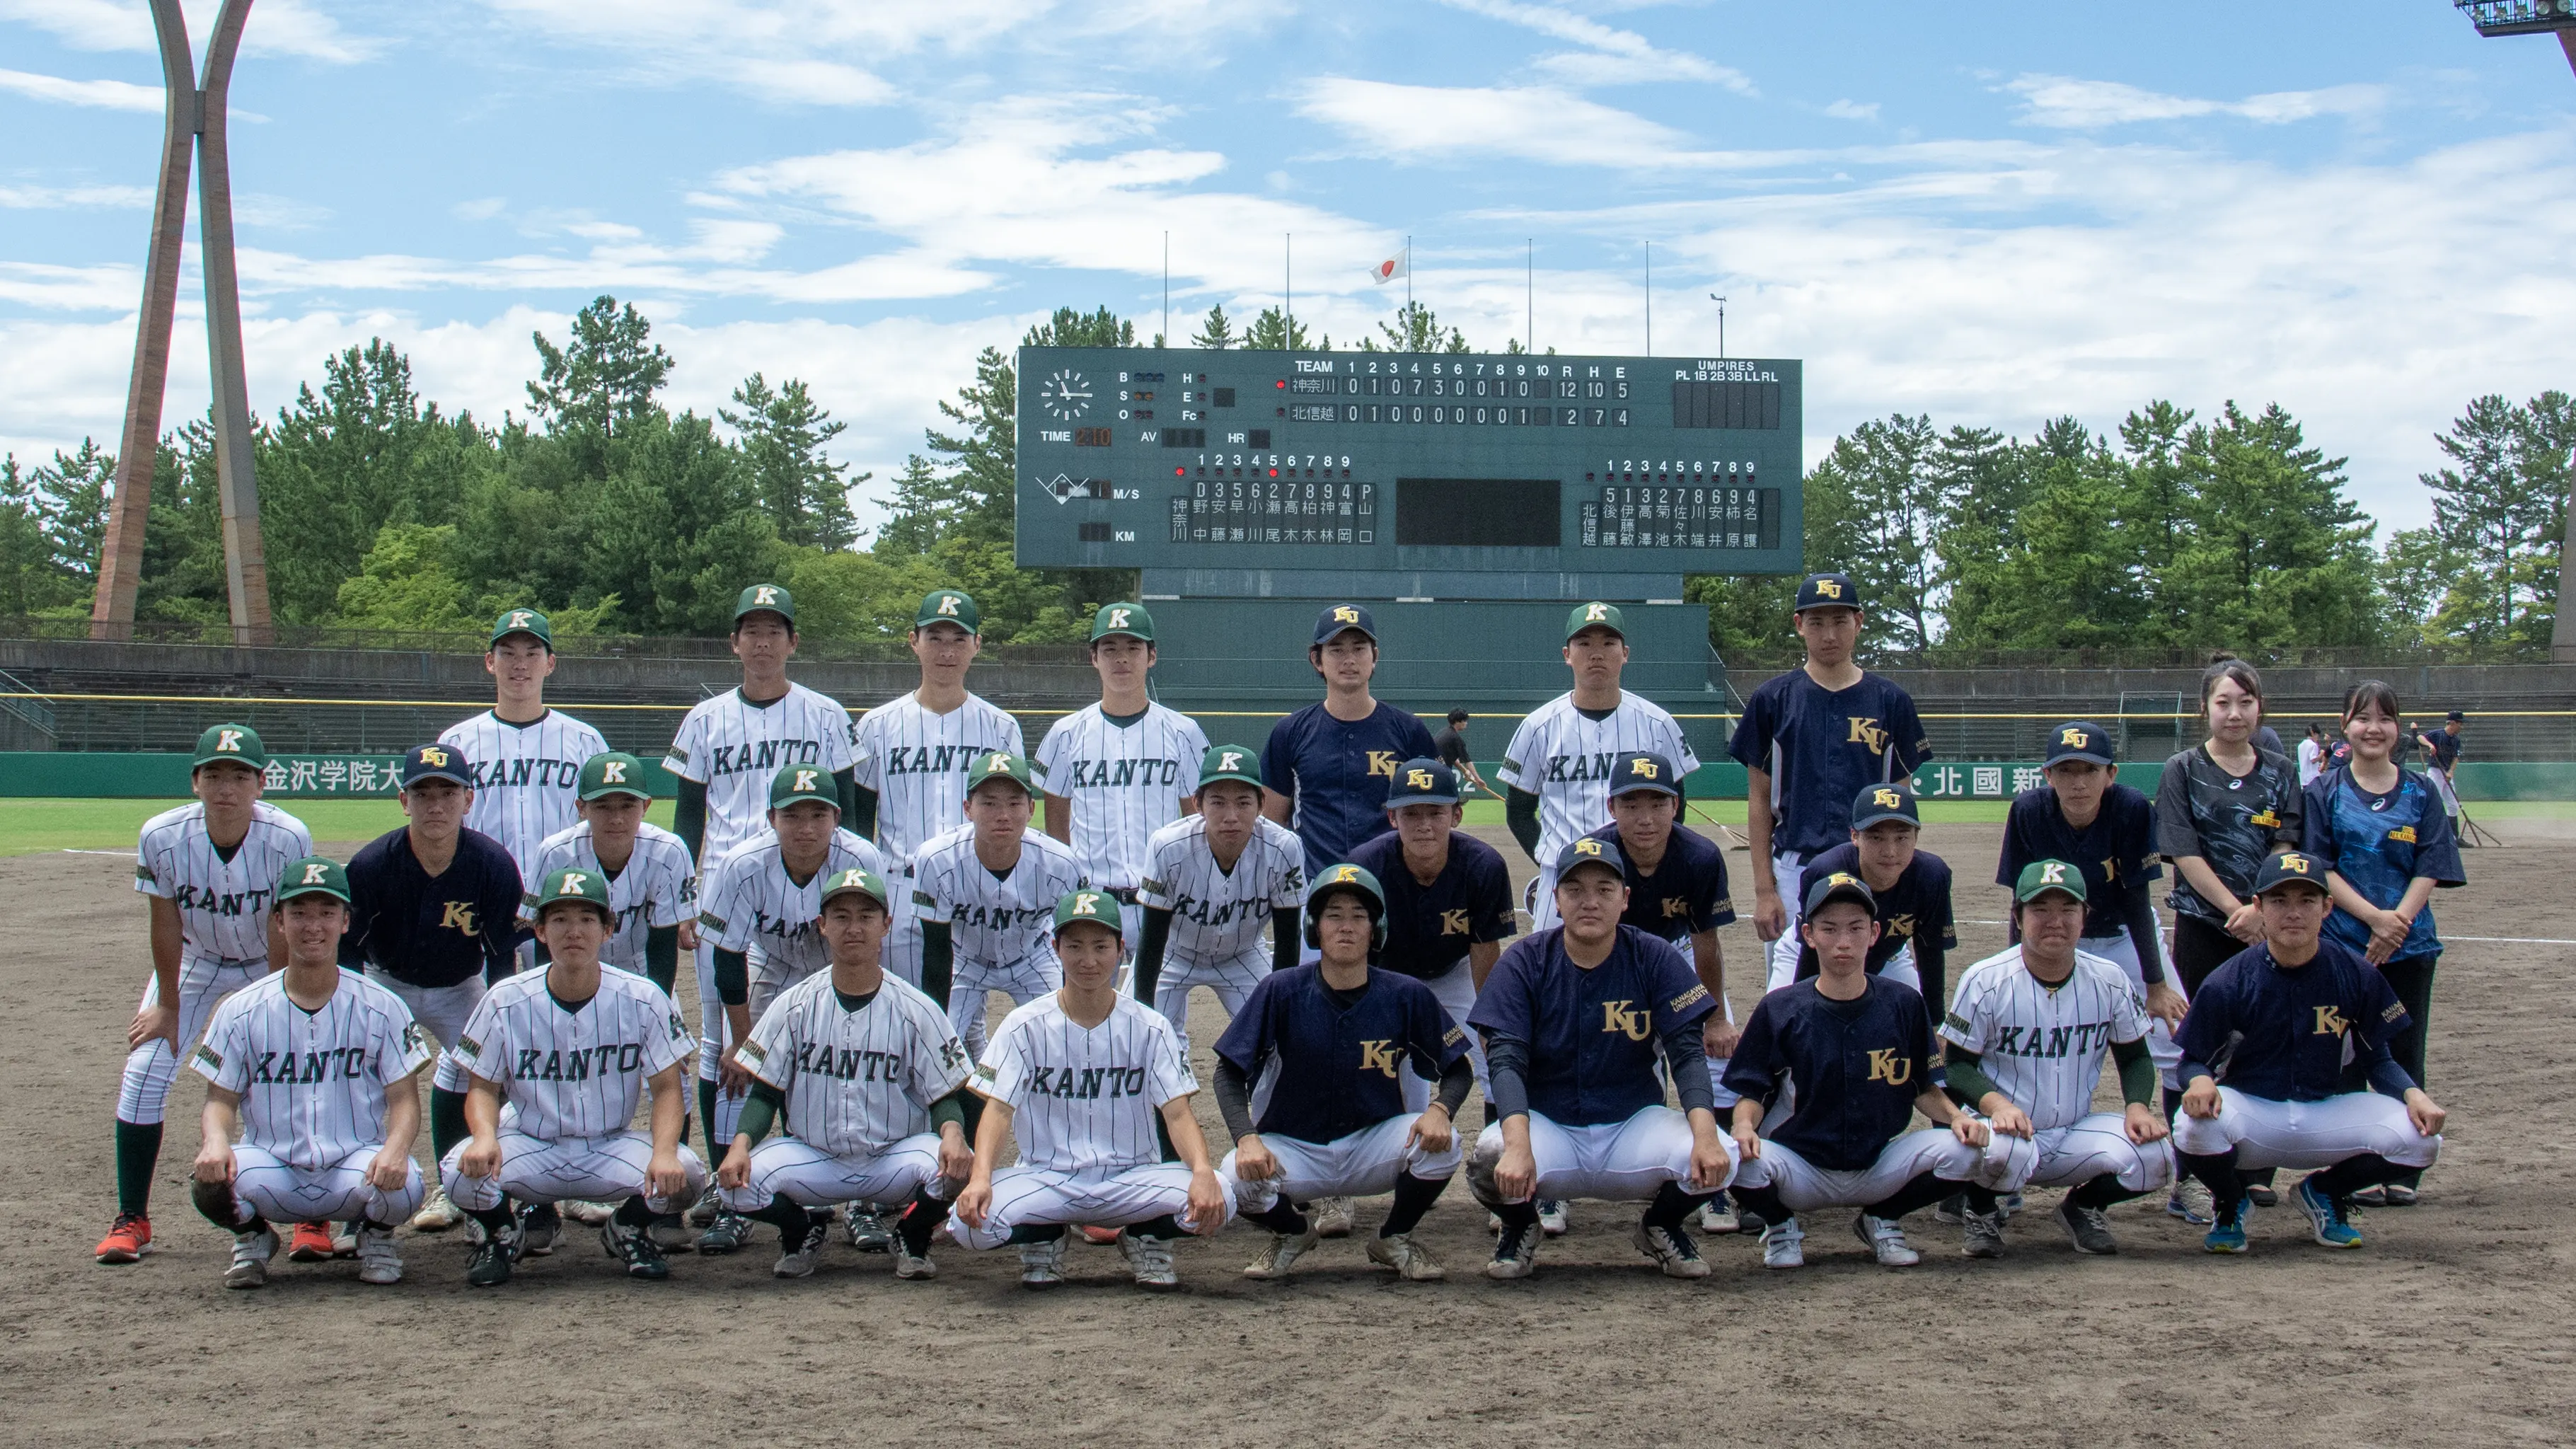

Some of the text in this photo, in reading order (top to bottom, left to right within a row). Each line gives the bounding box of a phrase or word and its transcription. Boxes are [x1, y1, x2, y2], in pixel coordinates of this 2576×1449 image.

[1295, 361, 1332, 372] TEAM
[1369, 362, 1377, 373] 2
[1390, 362, 1397, 373] 3
[1411, 363, 1419, 374] 4
[1433, 364, 1441, 374] 5
[1455, 364, 1462, 374] 6
[1477, 364, 1484, 375] 7
[1496, 364, 1504, 375] 8
[1518, 365, 1525, 376] 9
[1537, 365, 1549, 376] 10
[1563, 366, 1571, 376] R
[1590, 366, 1598, 377] H
[1617, 367, 1624, 378] E
[1676, 371, 1690, 380] PL
[1694, 371, 1707, 380] 1B
[1711, 371, 1725, 381] 2B
[1728, 371, 1743, 381] 3B
[1745, 371, 1760, 381] LL
[1699, 361, 1754, 371] UMPIRES
[1120, 372, 1128, 382] B
[1184, 374, 1191, 383] H
[1120, 391, 1127, 400] S
[1184, 392, 1191, 402] E
[1293, 379, 1334, 393] 神奈川
[1349, 379, 1357, 393] 0
[1392, 379, 1400, 394] 0
[1414, 379, 1421, 394] 7
[1435, 380, 1443, 395] 3
[1456, 381, 1464, 395] 0
[1477, 381, 1485, 396] 0
[1520, 381, 1527, 396] 0
[1561, 382, 1576, 397] 12
[1588, 383, 1603, 397] 10
[1619, 383, 1627, 398] 5
[1119, 410, 1128, 420] O
[1183, 410, 1196, 420] Fc
[1293, 407, 1334, 420] 北信越
[1349, 406, 1357, 421] 0
[1392, 407, 1399, 422] 0
[1414, 408, 1421, 422] 0
[1435, 408, 1443, 422] 0
[1456, 408, 1464, 422] 0
[1477, 408, 1485, 423] 0
[1498, 409, 1506, 423] 0
[1568, 410, 1576, 424] 2
[1596, 410, 1603, 425] 7
[1619, 410, 1627, 425] 4
[1041, 431, 1070, 441] TIME
[1141, 432, 1156, 441] AV
[1228, 433, 1244, 443] HR
[1215, 454, 1223, 465] 2
[1233, 455, 1241, 466] 3
[1252, 455, 1259, 466] 4
[1270, 455, 1277, 466] 5
[1288, 456, 1295, 466] 6
[1307, 456, 1315, 466] 7
[1324, 456, 1332, 466] 8
[1341, 456, 1349, 467] 9
[1114, 489, 1139, 499] M/S
[1197, 483, 1370, 499] D 3 5 6 2 7 8 9 4 P
[1607, 488, 1615, 502] 5
[1642, 488, 1650, 503] 3
[1660, 489, 1668, 503] 2
[1677, 489, 1685, 503] 7
[1695, 489, 1702, 504] 8
[1713, 490, 1720, 504] 6
[1730, 490, 1738, 504] 9
[1748, 490, 1755, 504] 4
[1116, 531, 1134, 541] KM
[754, 587, 778, 605] K
[1816, 579, 1842, 599] KU
[937, 596, 961, 616] K
[1334, 606, 1359, 624] KU
[1586, 604, 1608, 620] K
[509, 612, 533, 628] K
[1108, 608, 1131, 628] K
[216, 730, 243, 751] K
[1847, 717, 1889, 756] KU
[2061, 728, 2089, 749] KU
[421, 747, 447, 768] KU
[714, 739, 819, 775] KANTO
[988, 753, 1011, 772] K
[1218, 751, 1242, 771] K
[263, 759, 404, 792] 金沢学院大
[468, 758, 578, 790] KANTO
[603, 761, 627, 783] K
[1073, 758, 1178, 787] KANTO
[1631, 758, 1658, 779] KU
[793, 770, 818, 791] K
[1407, 768, 1433, 790] KU
[1873, 788, 1900, 809] KU
[2042, 863, 2067, 884] K
[2280, 853, 2310, 874] KU
[302, 864, 328, 884] K
[560, 873, 587, 894] K
[842, 869, 867, 887] K
[1334, 867, 1360, 883] K
[1073, 893, 1099, 914] K
[1670, 983, 1705, 1005] KANAGAWA
[1673, 988, 1709, 1012] UNIVERSITY
[1602, 1000, 1651, 1041] KU
[1996, 1021, 2111, 1058] KANTO
[253, 1047, 365, 1084] KANTO
[515, 1042, 641, 1082] KANTO
[797, 1041, 900, 1083] KANTO
[1866, 1048, 1910, 1086] KU
[1031, 1066, 1145, 1099] KANTO
